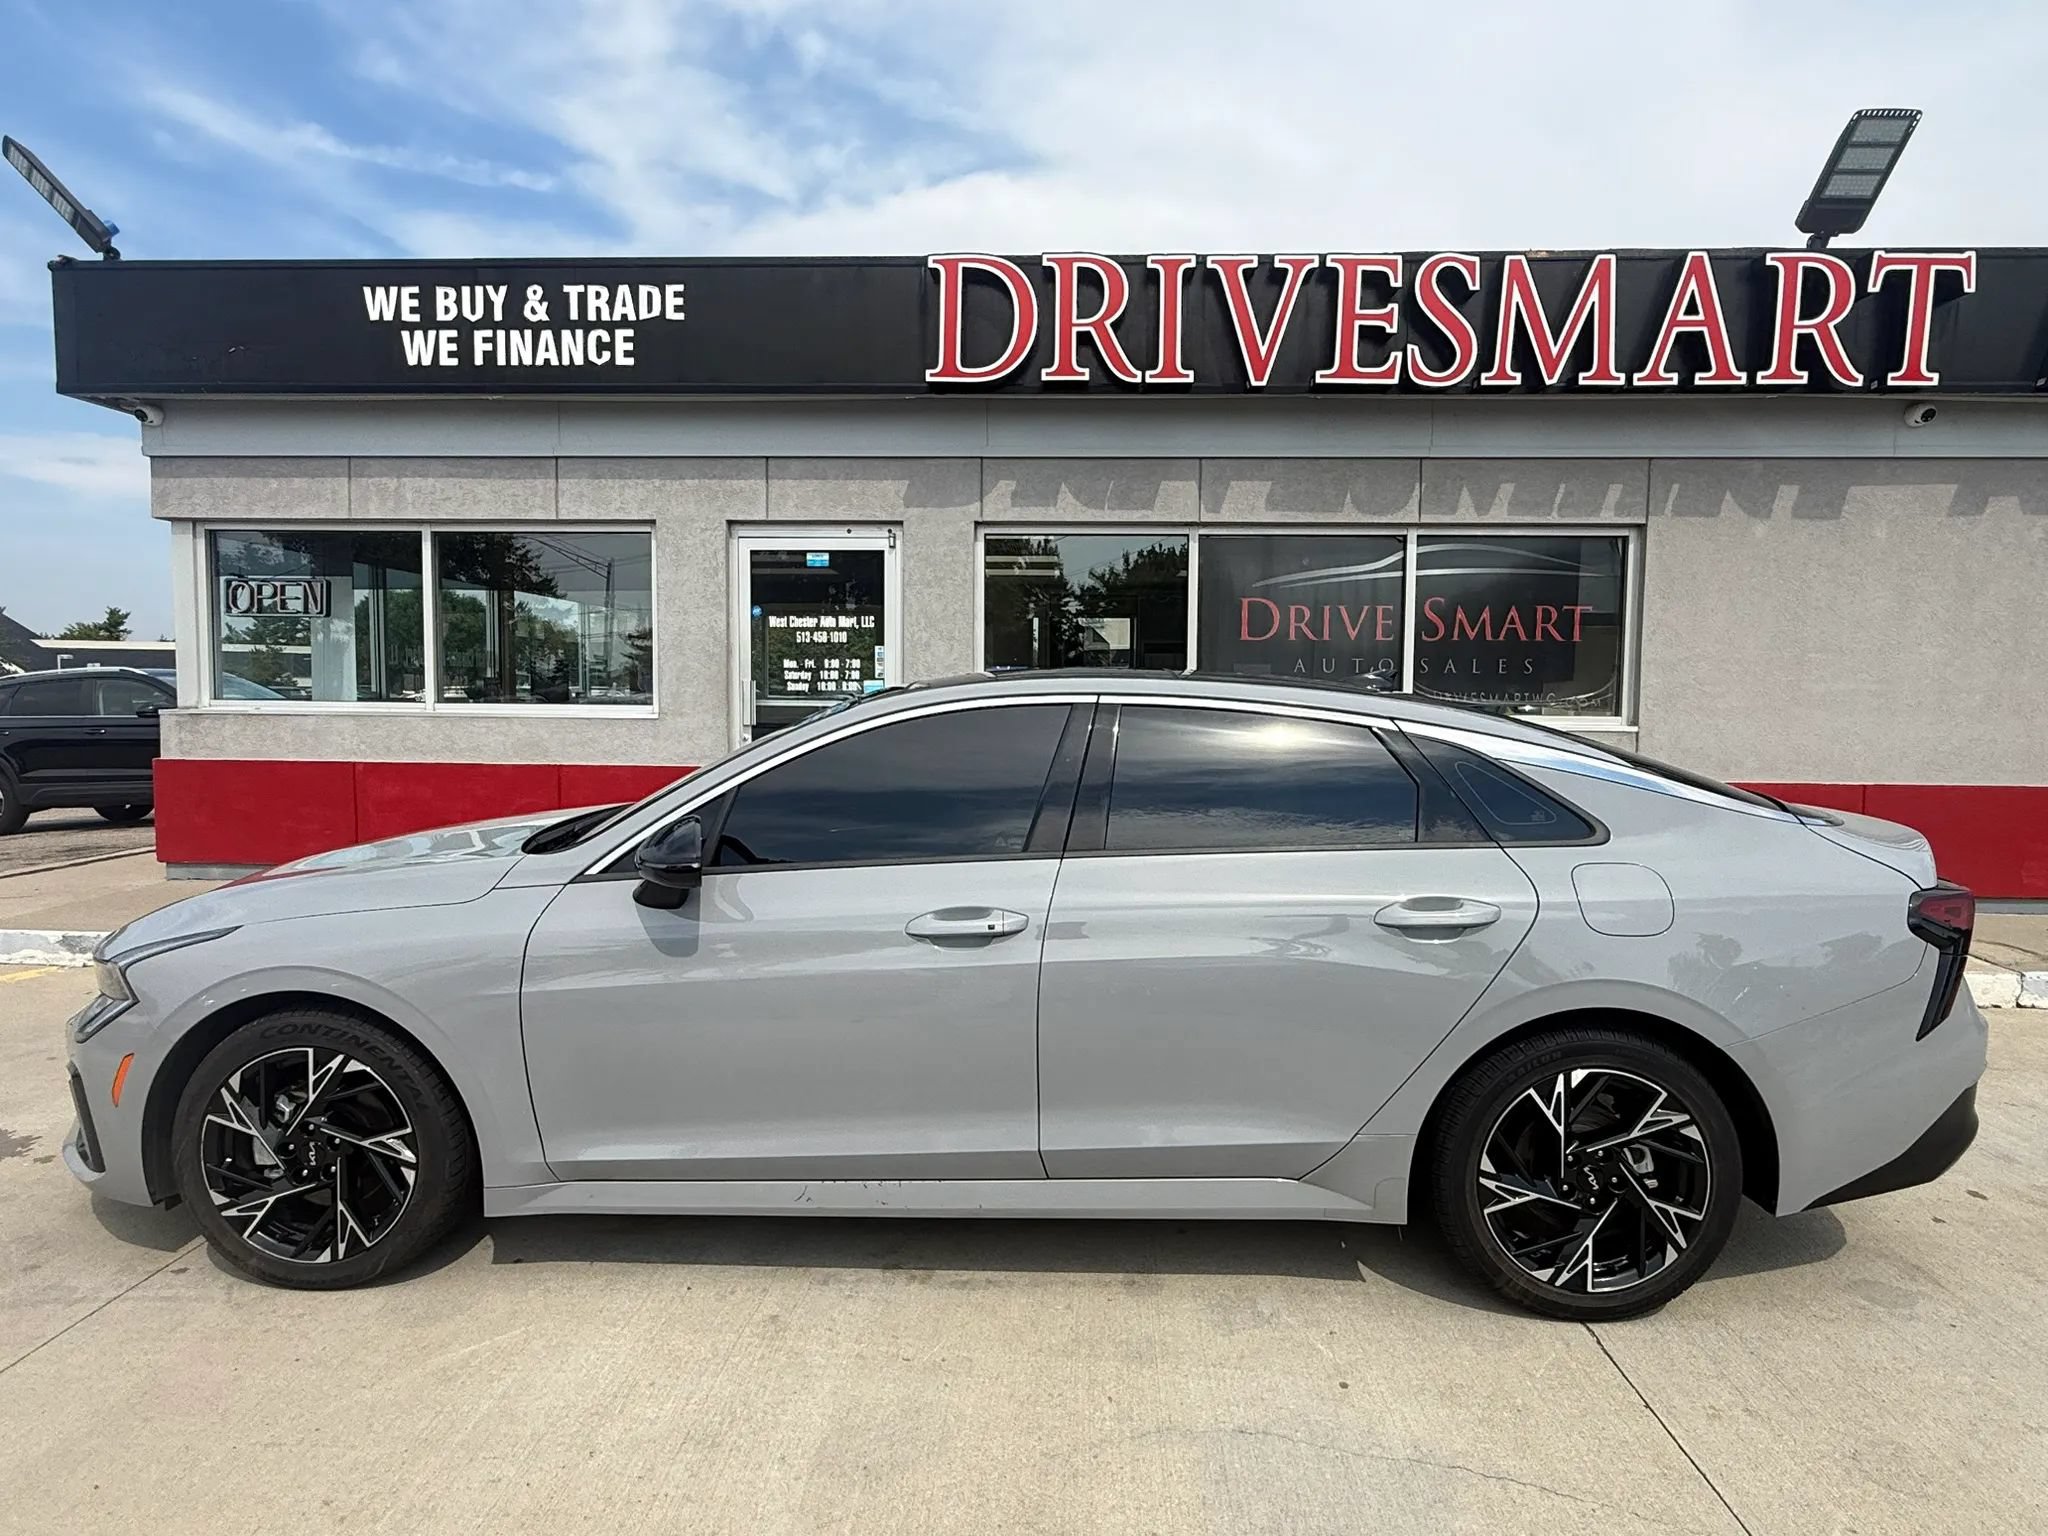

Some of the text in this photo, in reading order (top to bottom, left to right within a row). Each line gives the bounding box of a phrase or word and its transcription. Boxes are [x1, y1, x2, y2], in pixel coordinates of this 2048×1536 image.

[362, 284, 685, 323] WE BUY & TRADE
[925, 250, 1977, 388] DRIVESMART
[401, 328, 635, 366] WE FINANCE
[228, 580, 322, 614] OPEN
[769, 616, 875, 629] West Chester Auto Mart, LLC
[784, 670, 811, 681] Saturday
[1293, 658, 1534, 674] AUTO SALES
[787, 681, 809, 692] Sunday
